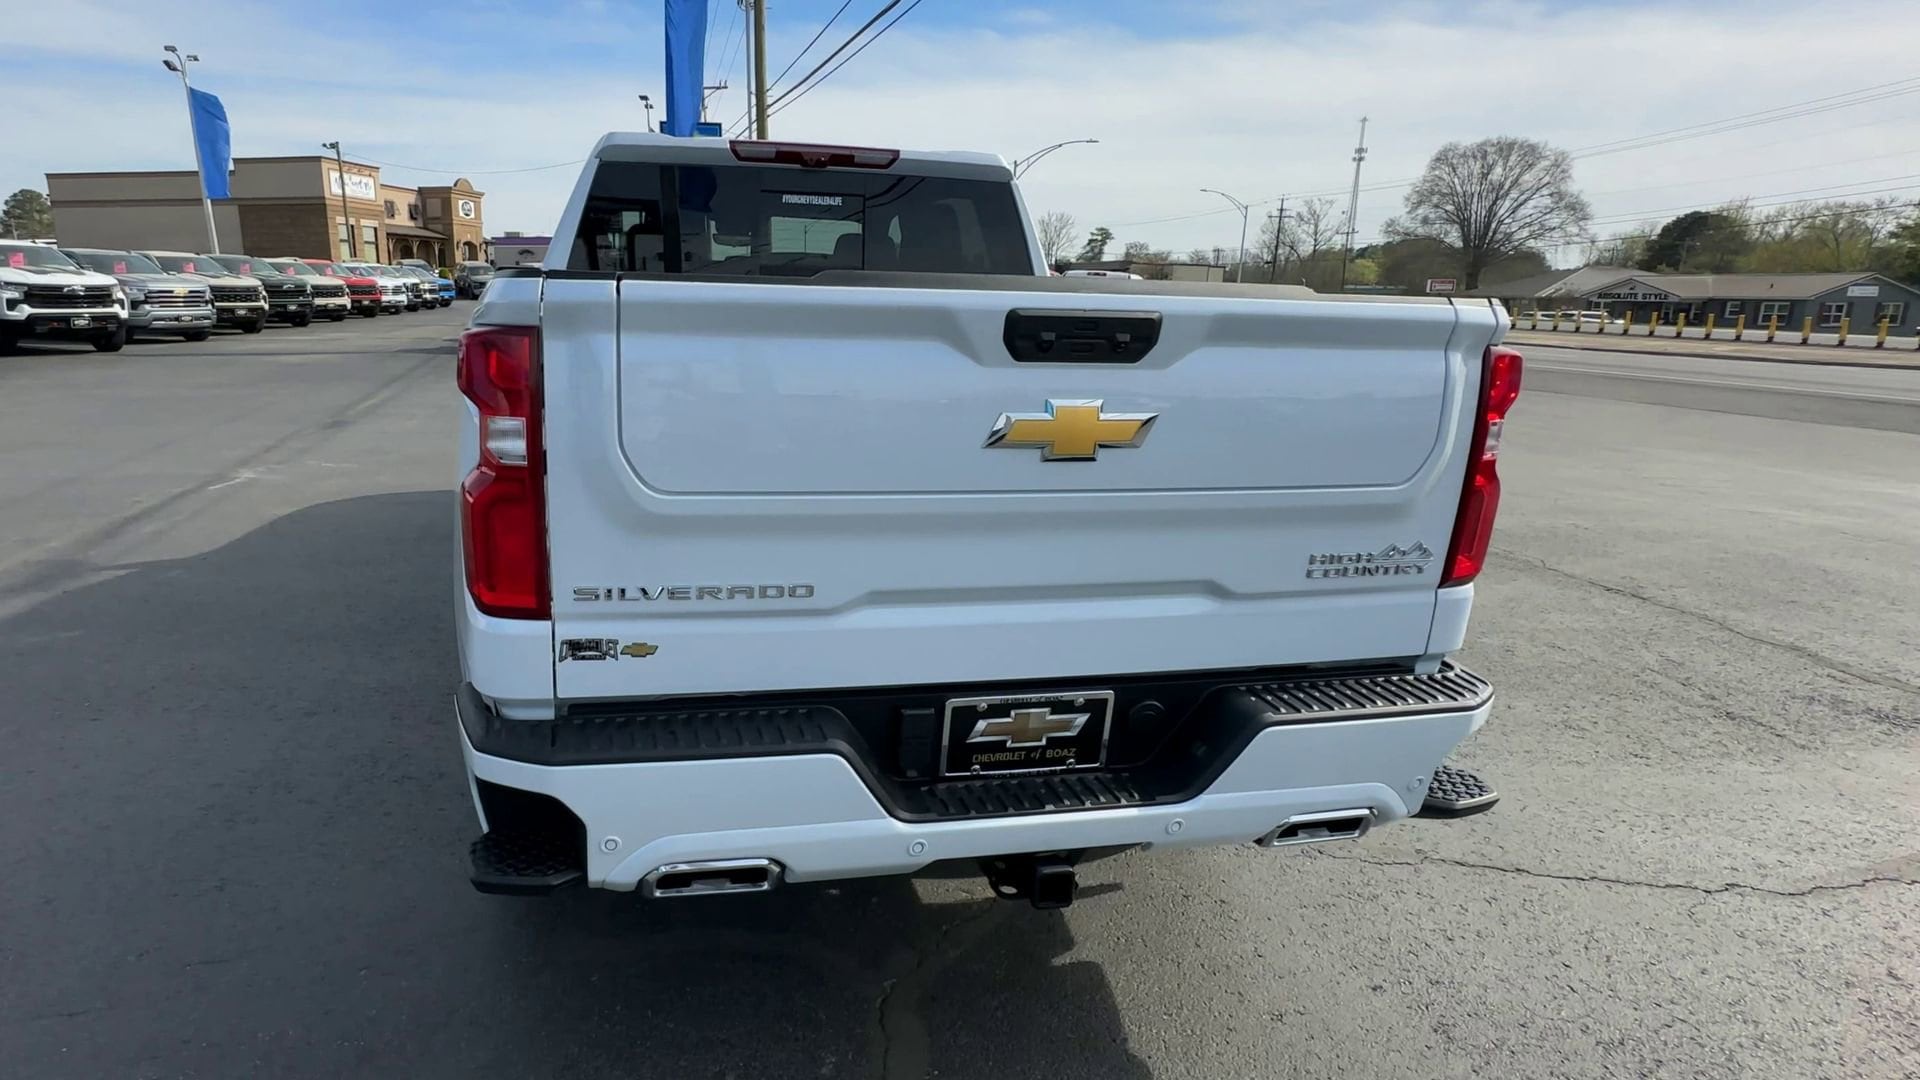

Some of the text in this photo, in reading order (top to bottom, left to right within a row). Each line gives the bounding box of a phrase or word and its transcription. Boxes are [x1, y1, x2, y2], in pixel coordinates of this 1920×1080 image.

[1597, 292, 1669, 300] ABSOLUTE STYLE
[1308, 552, 1374, 566] HIGH
[1306, 564, 1426, 579] COUNTRY
[573, 583, 815, 602] SILVERADO
[972, 747, 1077, 763] CHEVROLET of BOAZ
